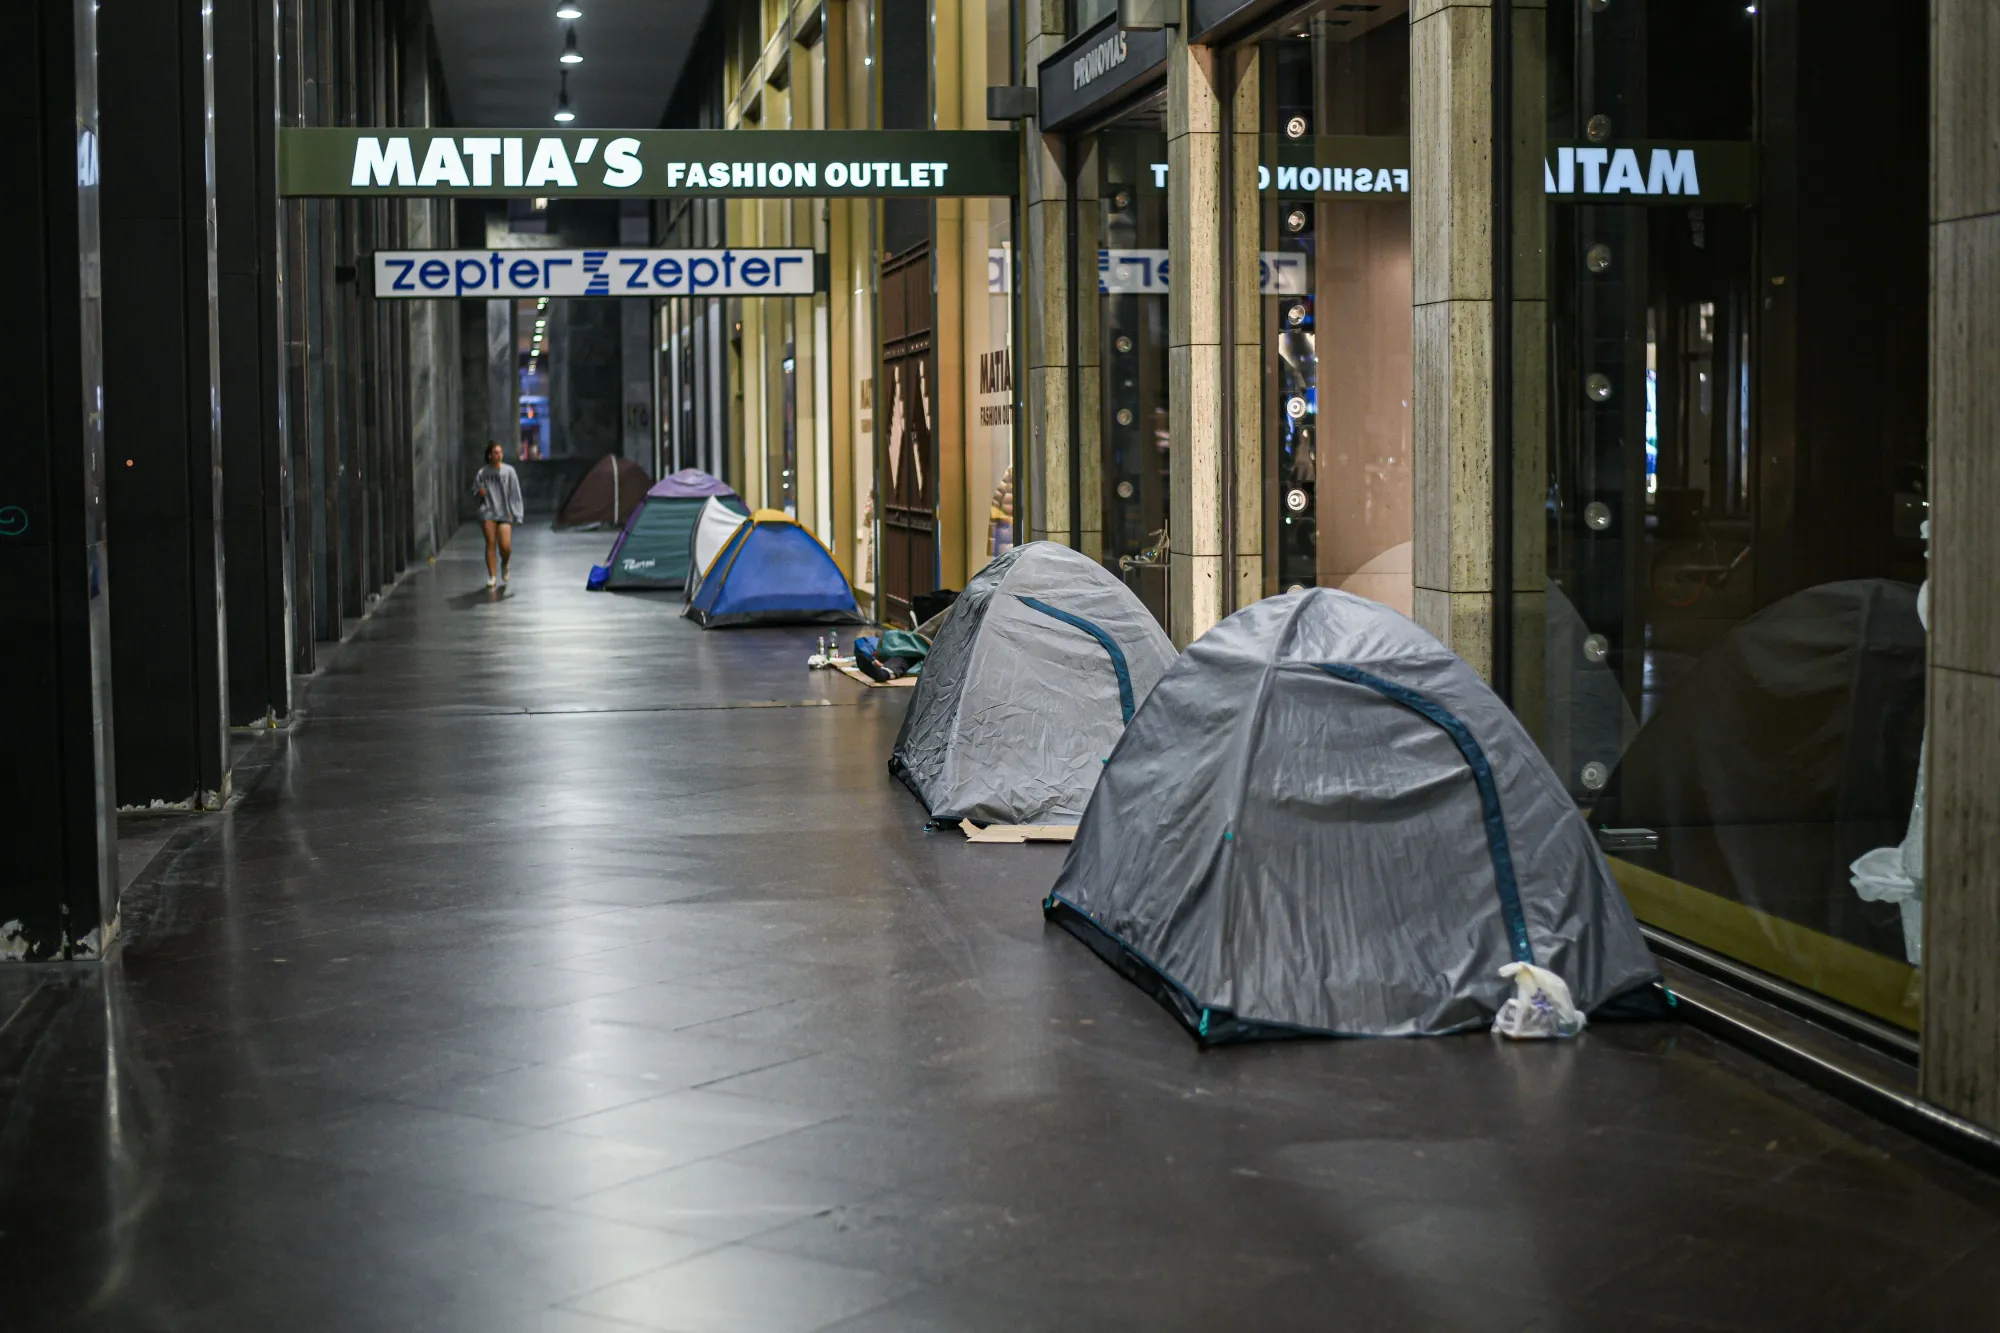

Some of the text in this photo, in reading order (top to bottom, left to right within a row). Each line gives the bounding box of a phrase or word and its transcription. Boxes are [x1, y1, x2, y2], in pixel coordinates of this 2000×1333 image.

[1073, 30, 1127, 91] PRONOVIAS
[351, 137, 948, 188] MATIA'S FASHION OUTLET
[384, 252, 573, 296] zepter
[619, 250, 803, 294] zepter
[980, 405, 1001, 426] FASHION
